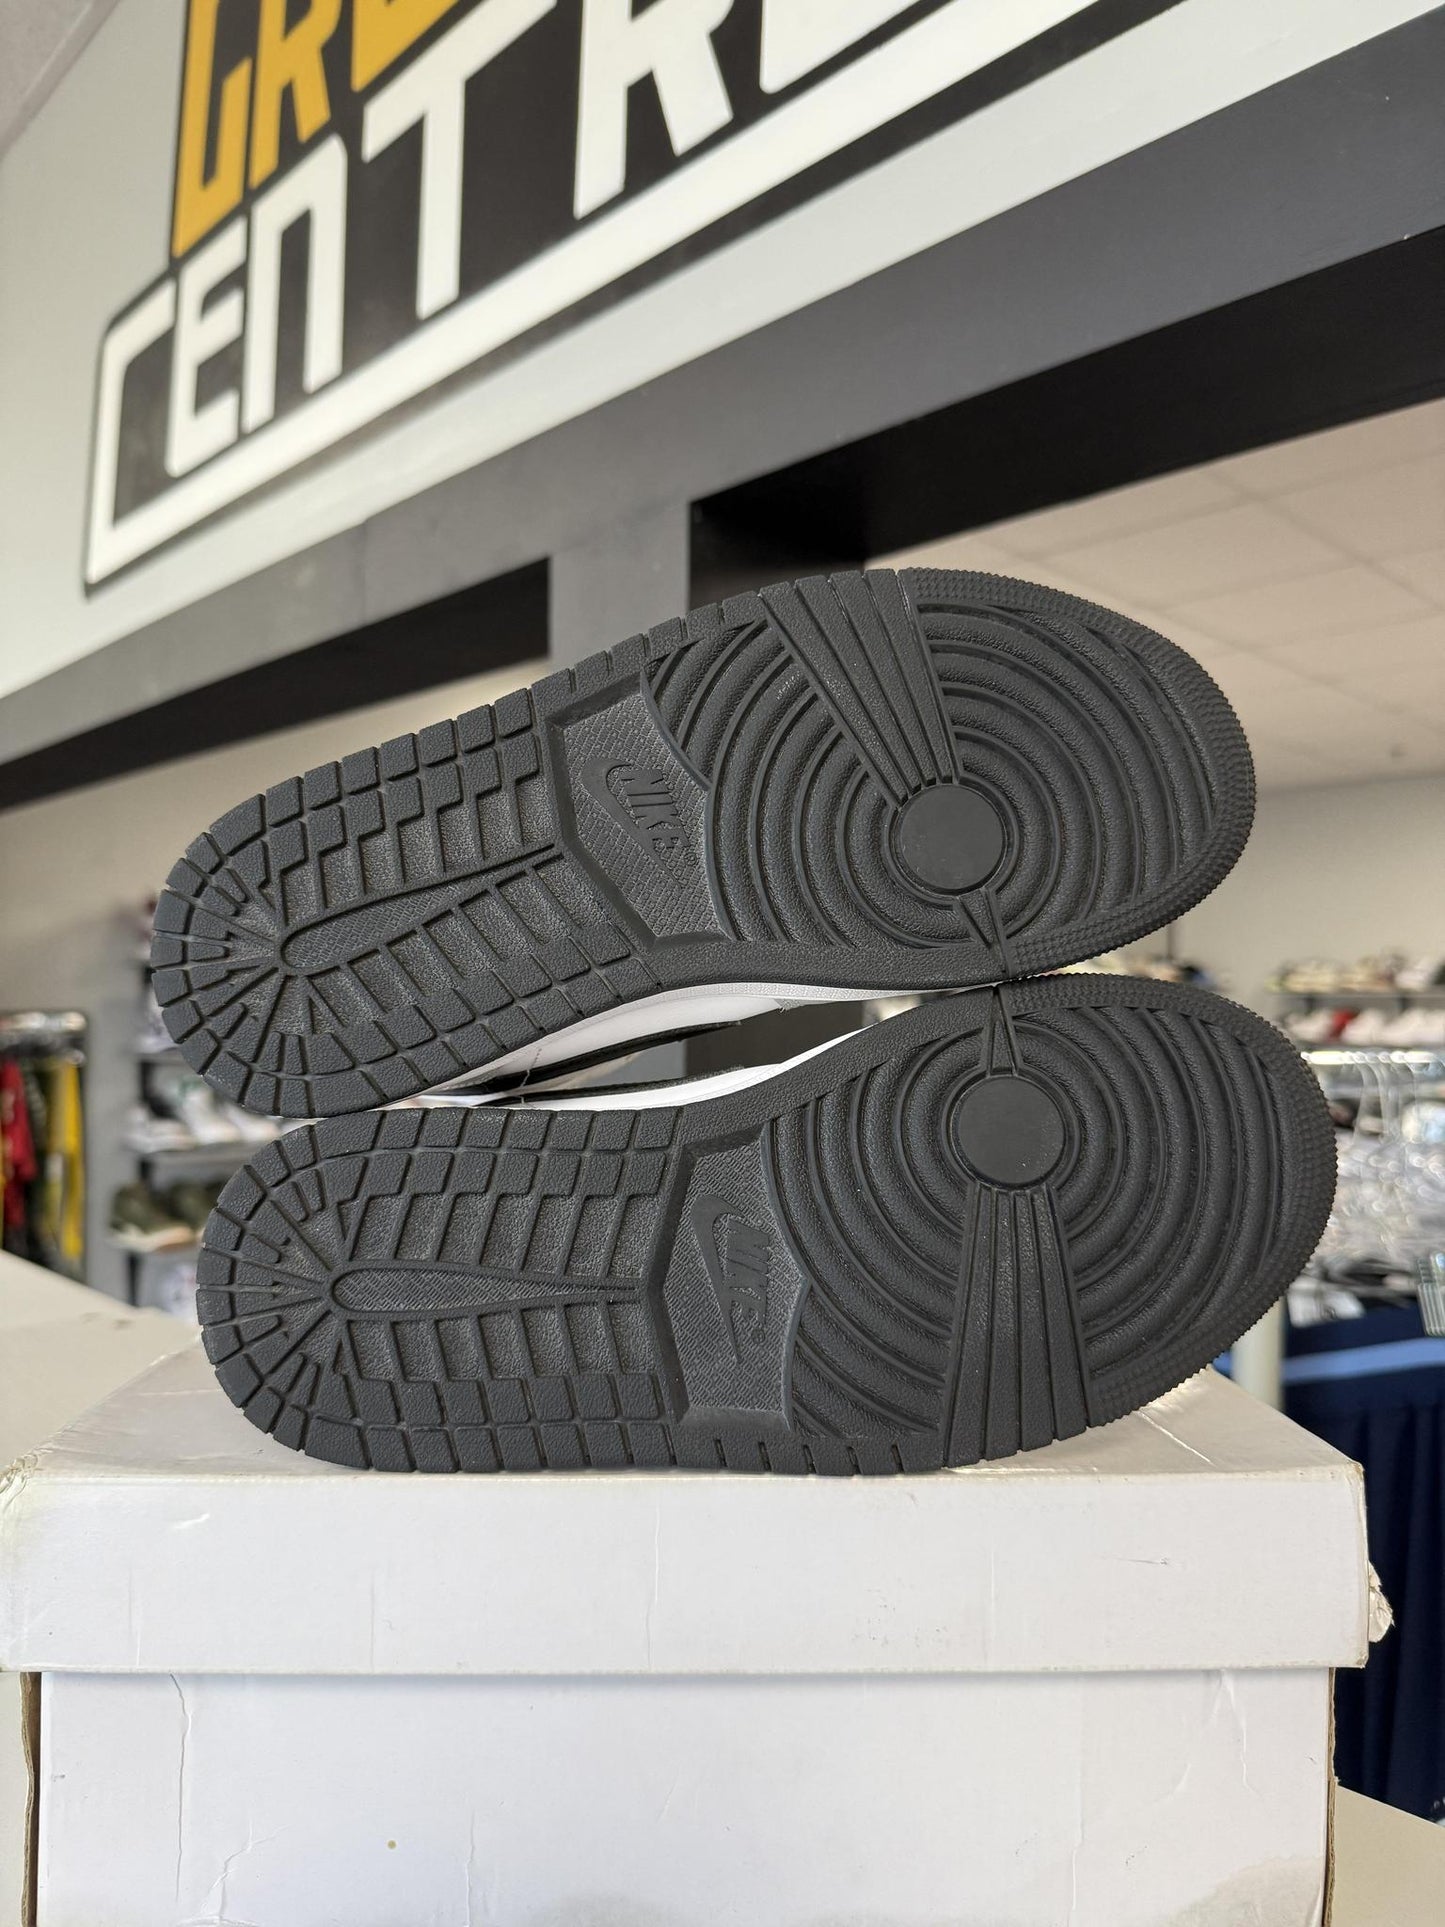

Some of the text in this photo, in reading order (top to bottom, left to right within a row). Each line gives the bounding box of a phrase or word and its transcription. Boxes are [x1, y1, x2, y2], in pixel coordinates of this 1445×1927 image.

[171, 0, 460, 259] CR
[620, 767, 693, 852] NIKE
[726, 1216, 771, 1325] NIKE
